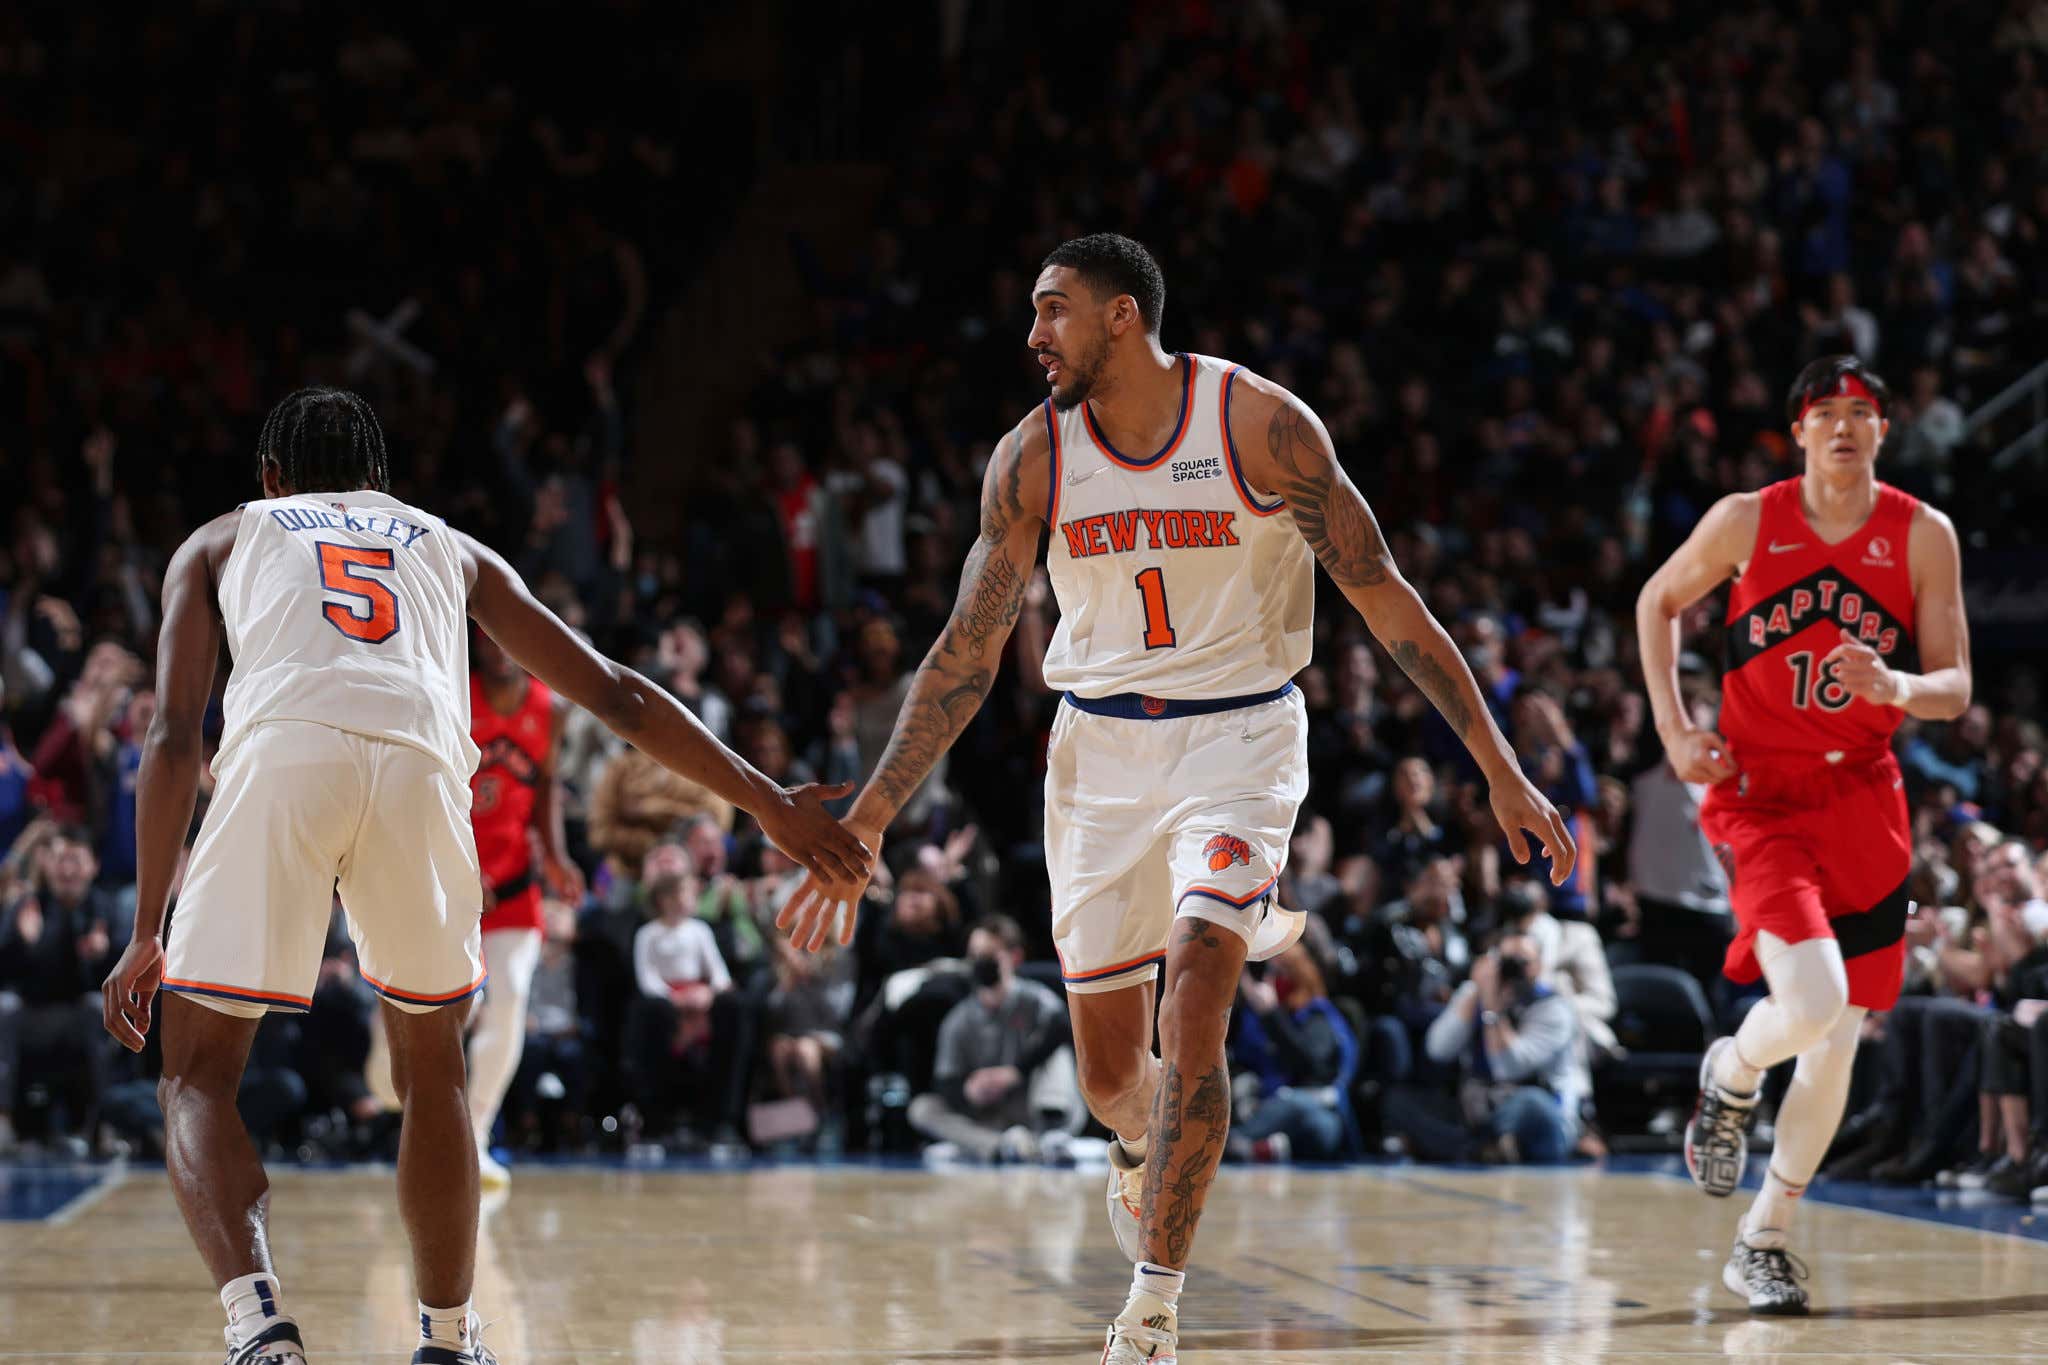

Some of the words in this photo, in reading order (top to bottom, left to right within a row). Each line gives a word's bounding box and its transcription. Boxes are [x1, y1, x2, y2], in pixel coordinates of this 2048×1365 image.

[1171, 457, 1219, 472] SQUARE
[1172, 469, 1211, 482] SPACE
[271, 508, 430, 548] QUICKLEY
[1061, 508, 1139, 559] NEW
[1141, 510, 1240, 549] YORK
[315, 541, 400, 644] 5
[1135, 567, 1176, 650] 1
[1748, 580, 1898, 654] RAPTORS
[1785, 651, 1854, 714] 18
